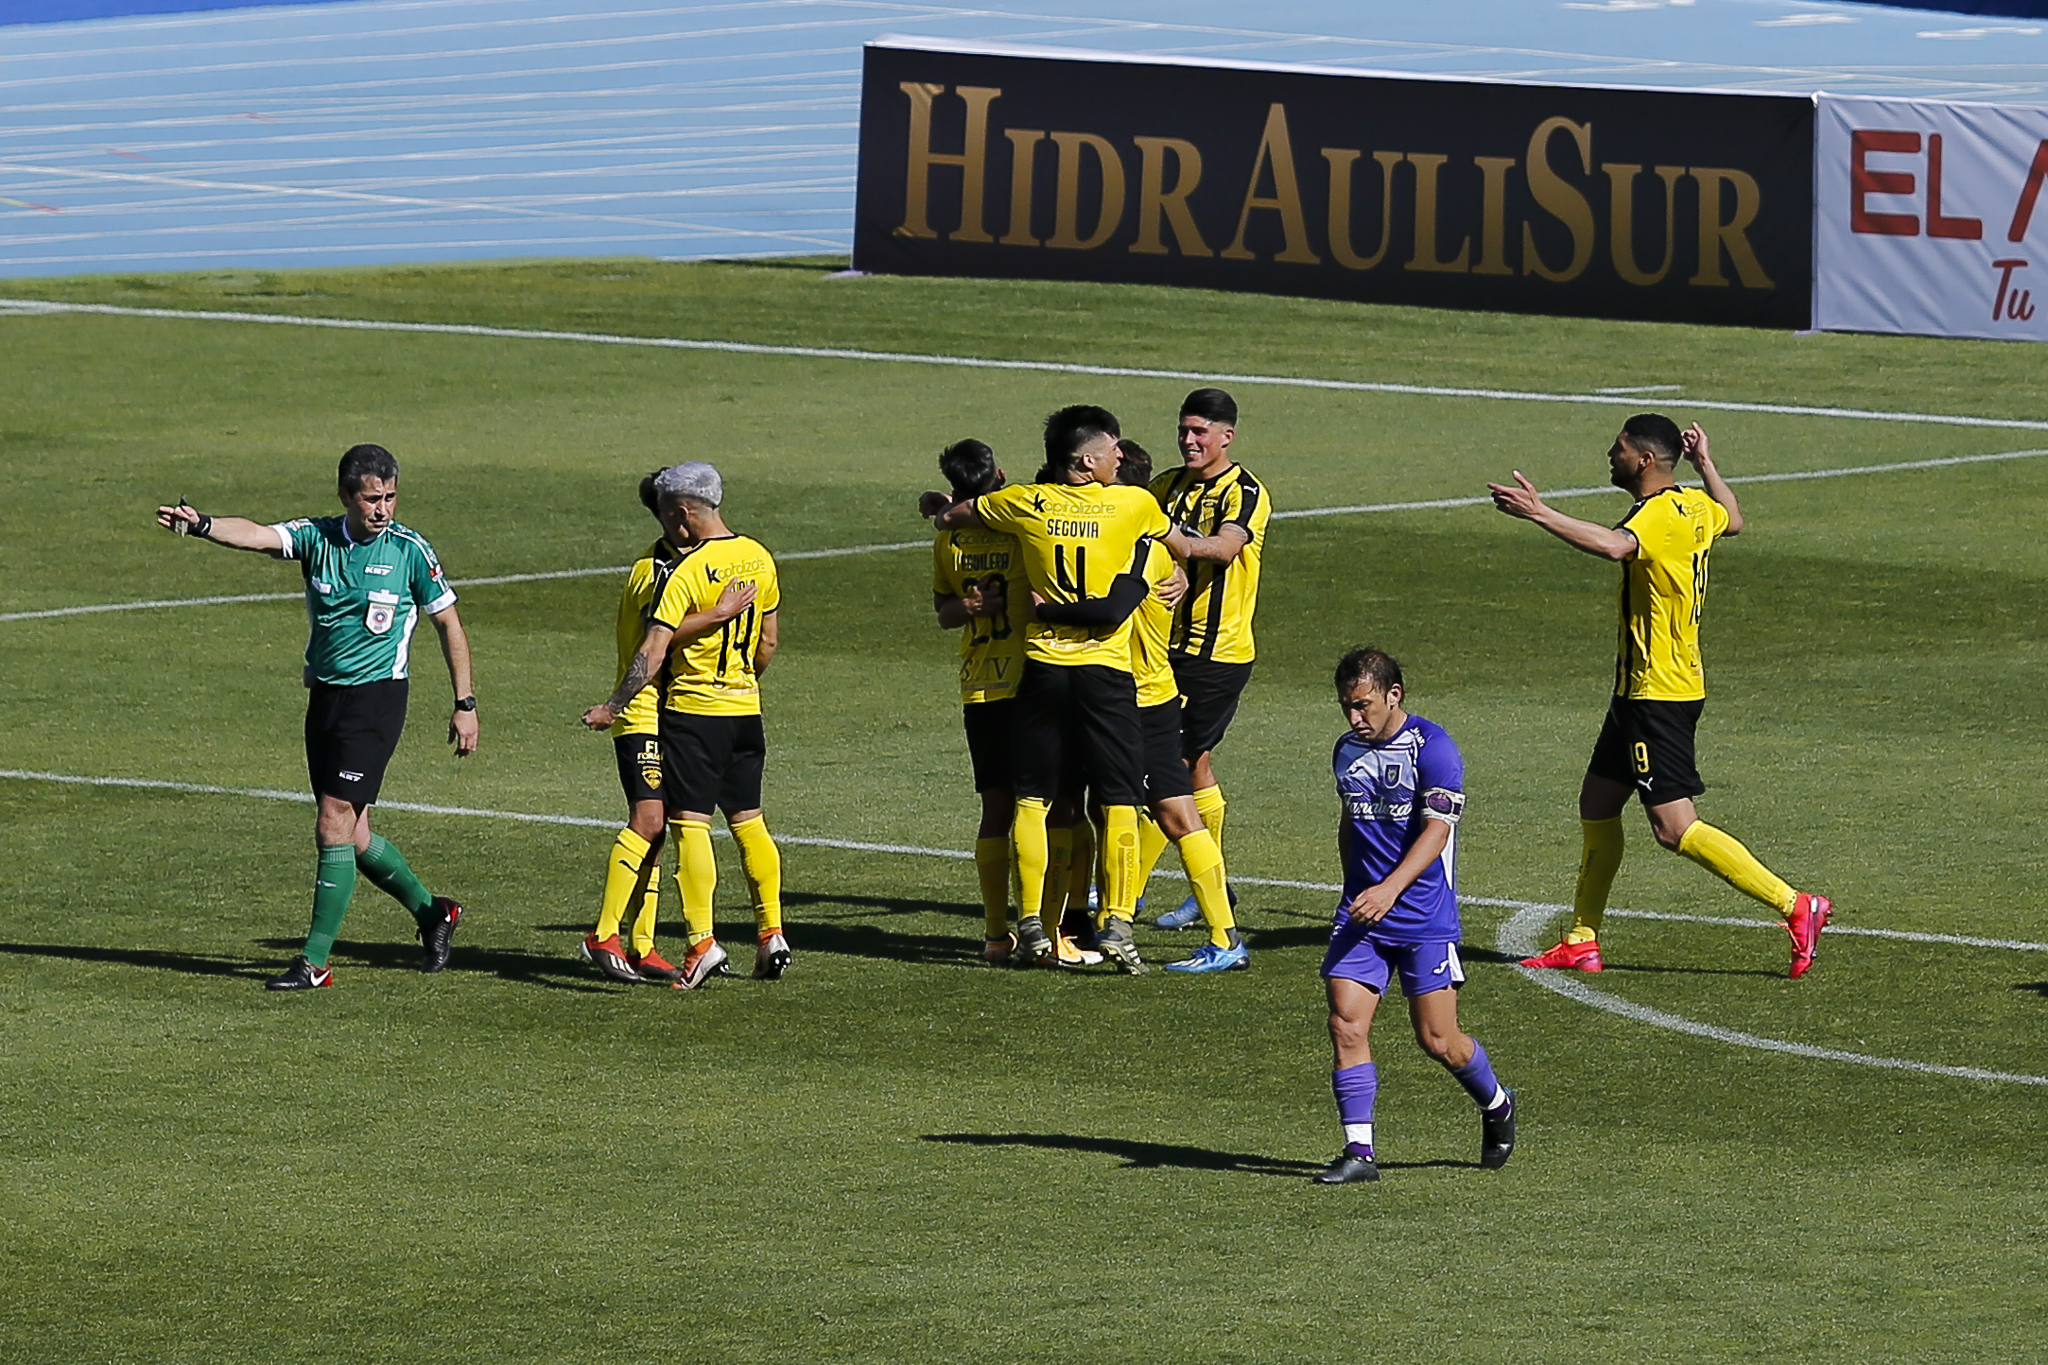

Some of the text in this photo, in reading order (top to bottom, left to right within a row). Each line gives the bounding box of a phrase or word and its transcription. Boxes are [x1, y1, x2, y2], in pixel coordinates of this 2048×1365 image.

[892, 81, 1775, 289] HIDRAULISUR
[1992, 259, 2035, 321] Tu
[1047, 518, 1099, 538] SEGOVIA
[717, 602, 755, 677] 14
